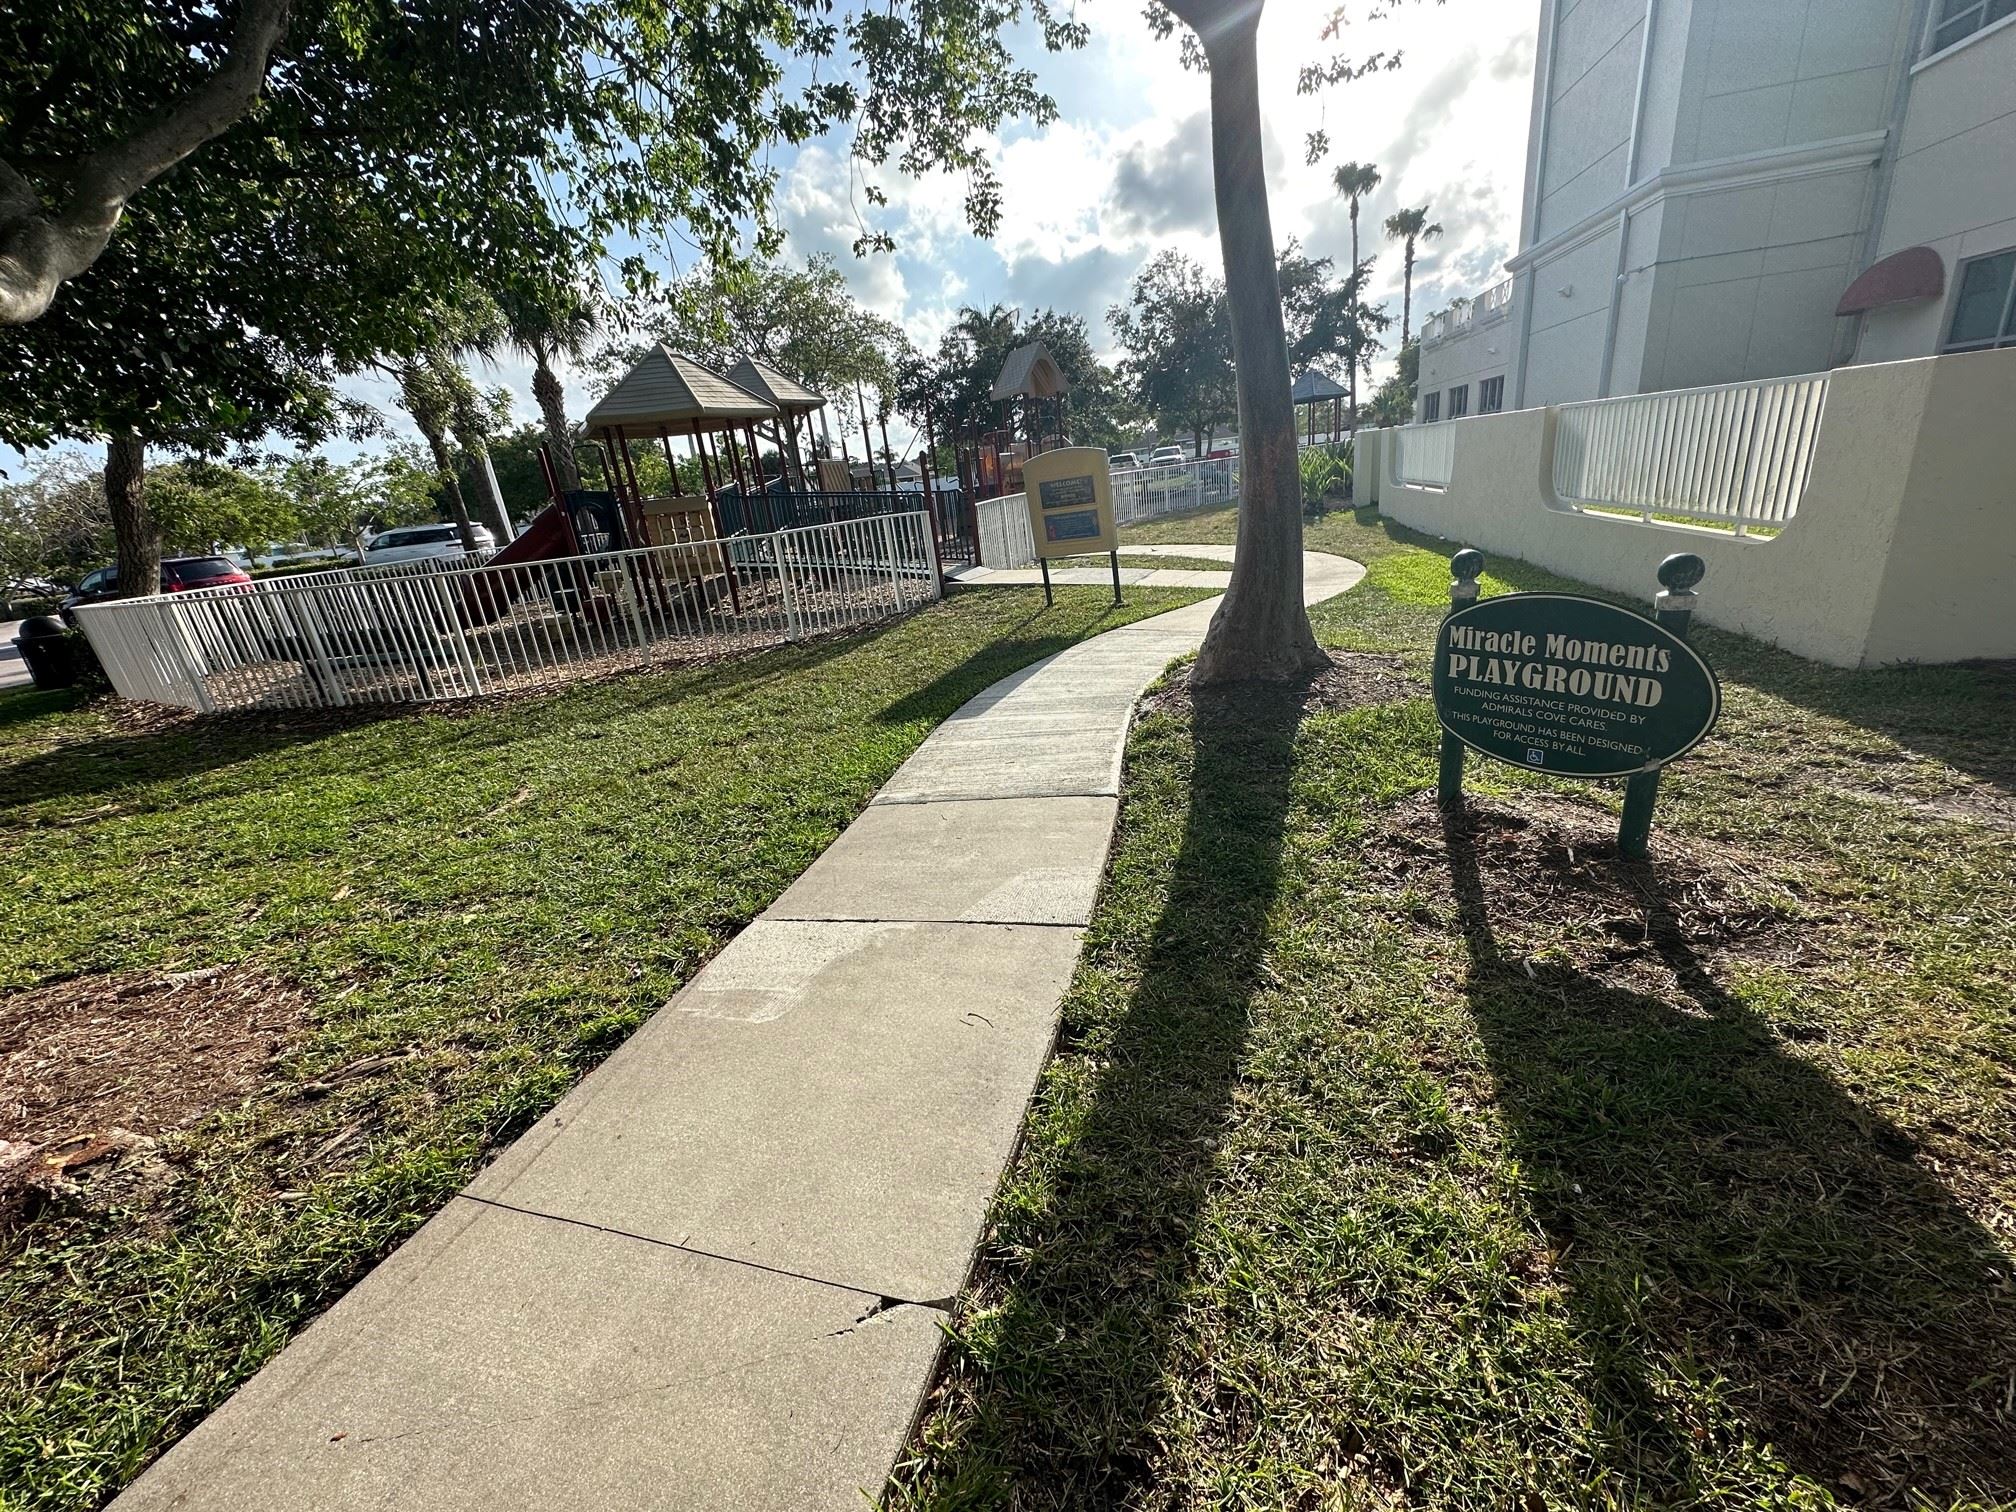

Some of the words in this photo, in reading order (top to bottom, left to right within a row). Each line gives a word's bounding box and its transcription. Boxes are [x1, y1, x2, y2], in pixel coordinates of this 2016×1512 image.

[1449, 625, 1536, 656] Miracle
[1544, 633, 1671, 673] Moments
[1448, 653, 1662, 707] PLAYGROUND
[1454, 686, 1500, 700] FUNDING
[1502, 693, 1565, 710] ASSISTANCE
[1568, 703, 1626, 721] PROVIDED
[1630, 714, 1646, 725] BY
[1481, 702, 1533, 717] ADMIRALS
[1535, 710, 1566, 723] COVE
[1452, 711, 1470, 721] THIS
[1472, 715, 1535, 733] PLAYGROUND
[1537, 726, 1557, 738] HAS
[1560, 730, 1585, 743] BEEN
[1588, 736, 1642, 755] DESIGNED
[1493, 730, 1511, 741] FOR
[1513, 734, 1549, 748] ACCESS
[1552, 742, 1565, 751] BY
